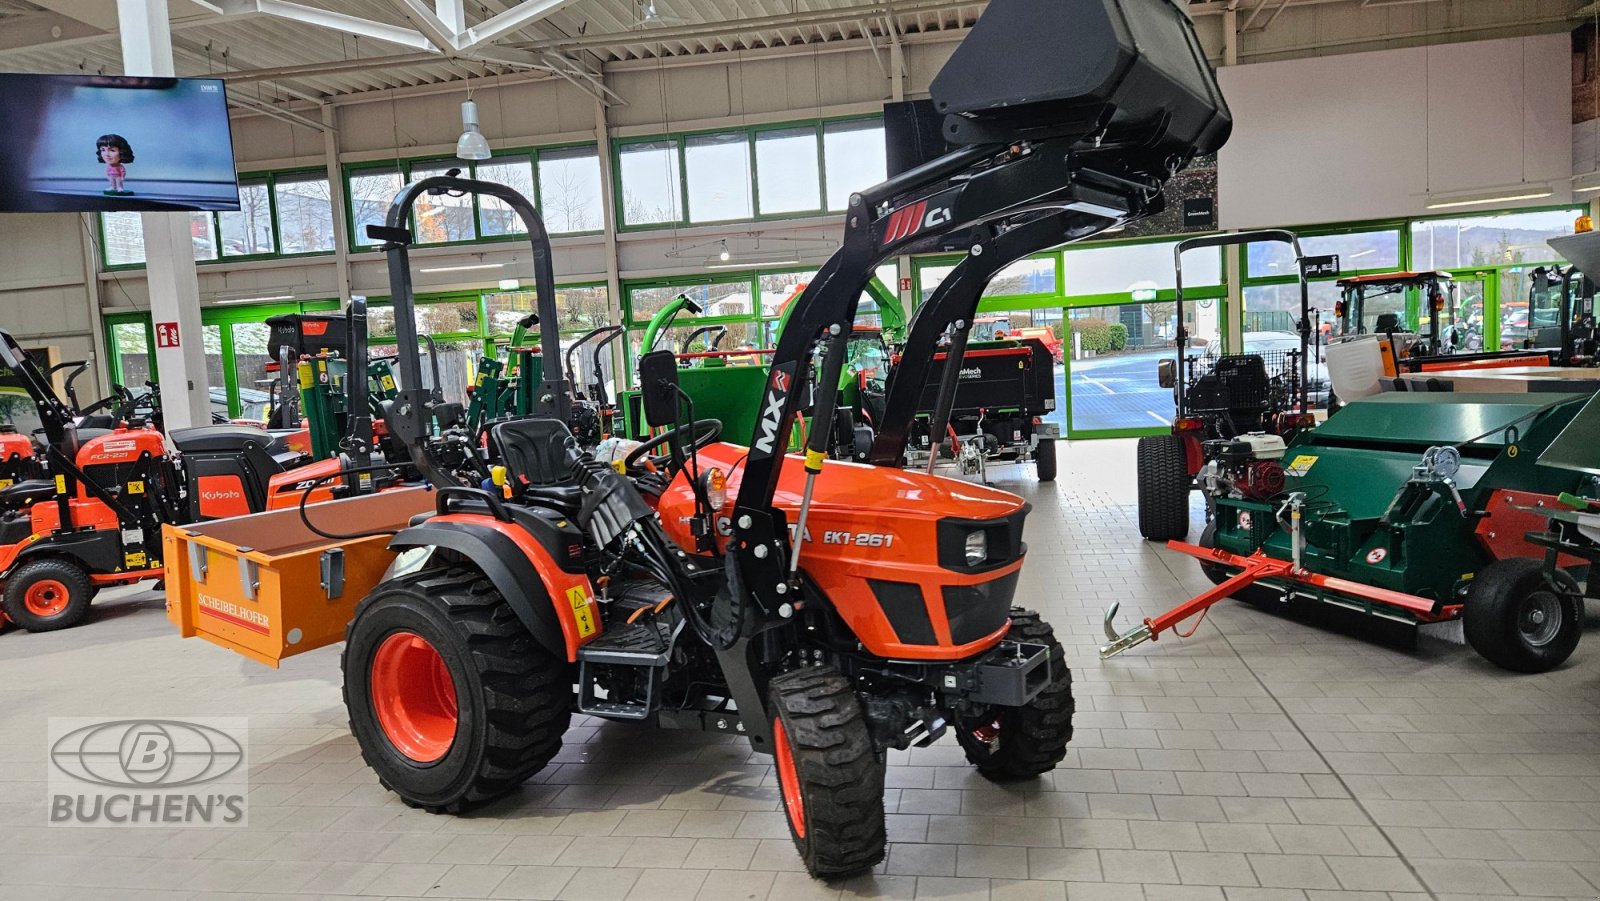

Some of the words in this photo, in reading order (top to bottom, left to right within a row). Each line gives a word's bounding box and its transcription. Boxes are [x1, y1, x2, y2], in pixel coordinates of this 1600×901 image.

[924, 207, 952, 228] C1
[959, 367, 982, 375] nMech
[755, 390, 786, 454] MX
[201, 490, 241, 500] Kubota
[823, 530, 894, 548] EK1-261
[198, 593, 270, 628] SCHEIBELHOFER
